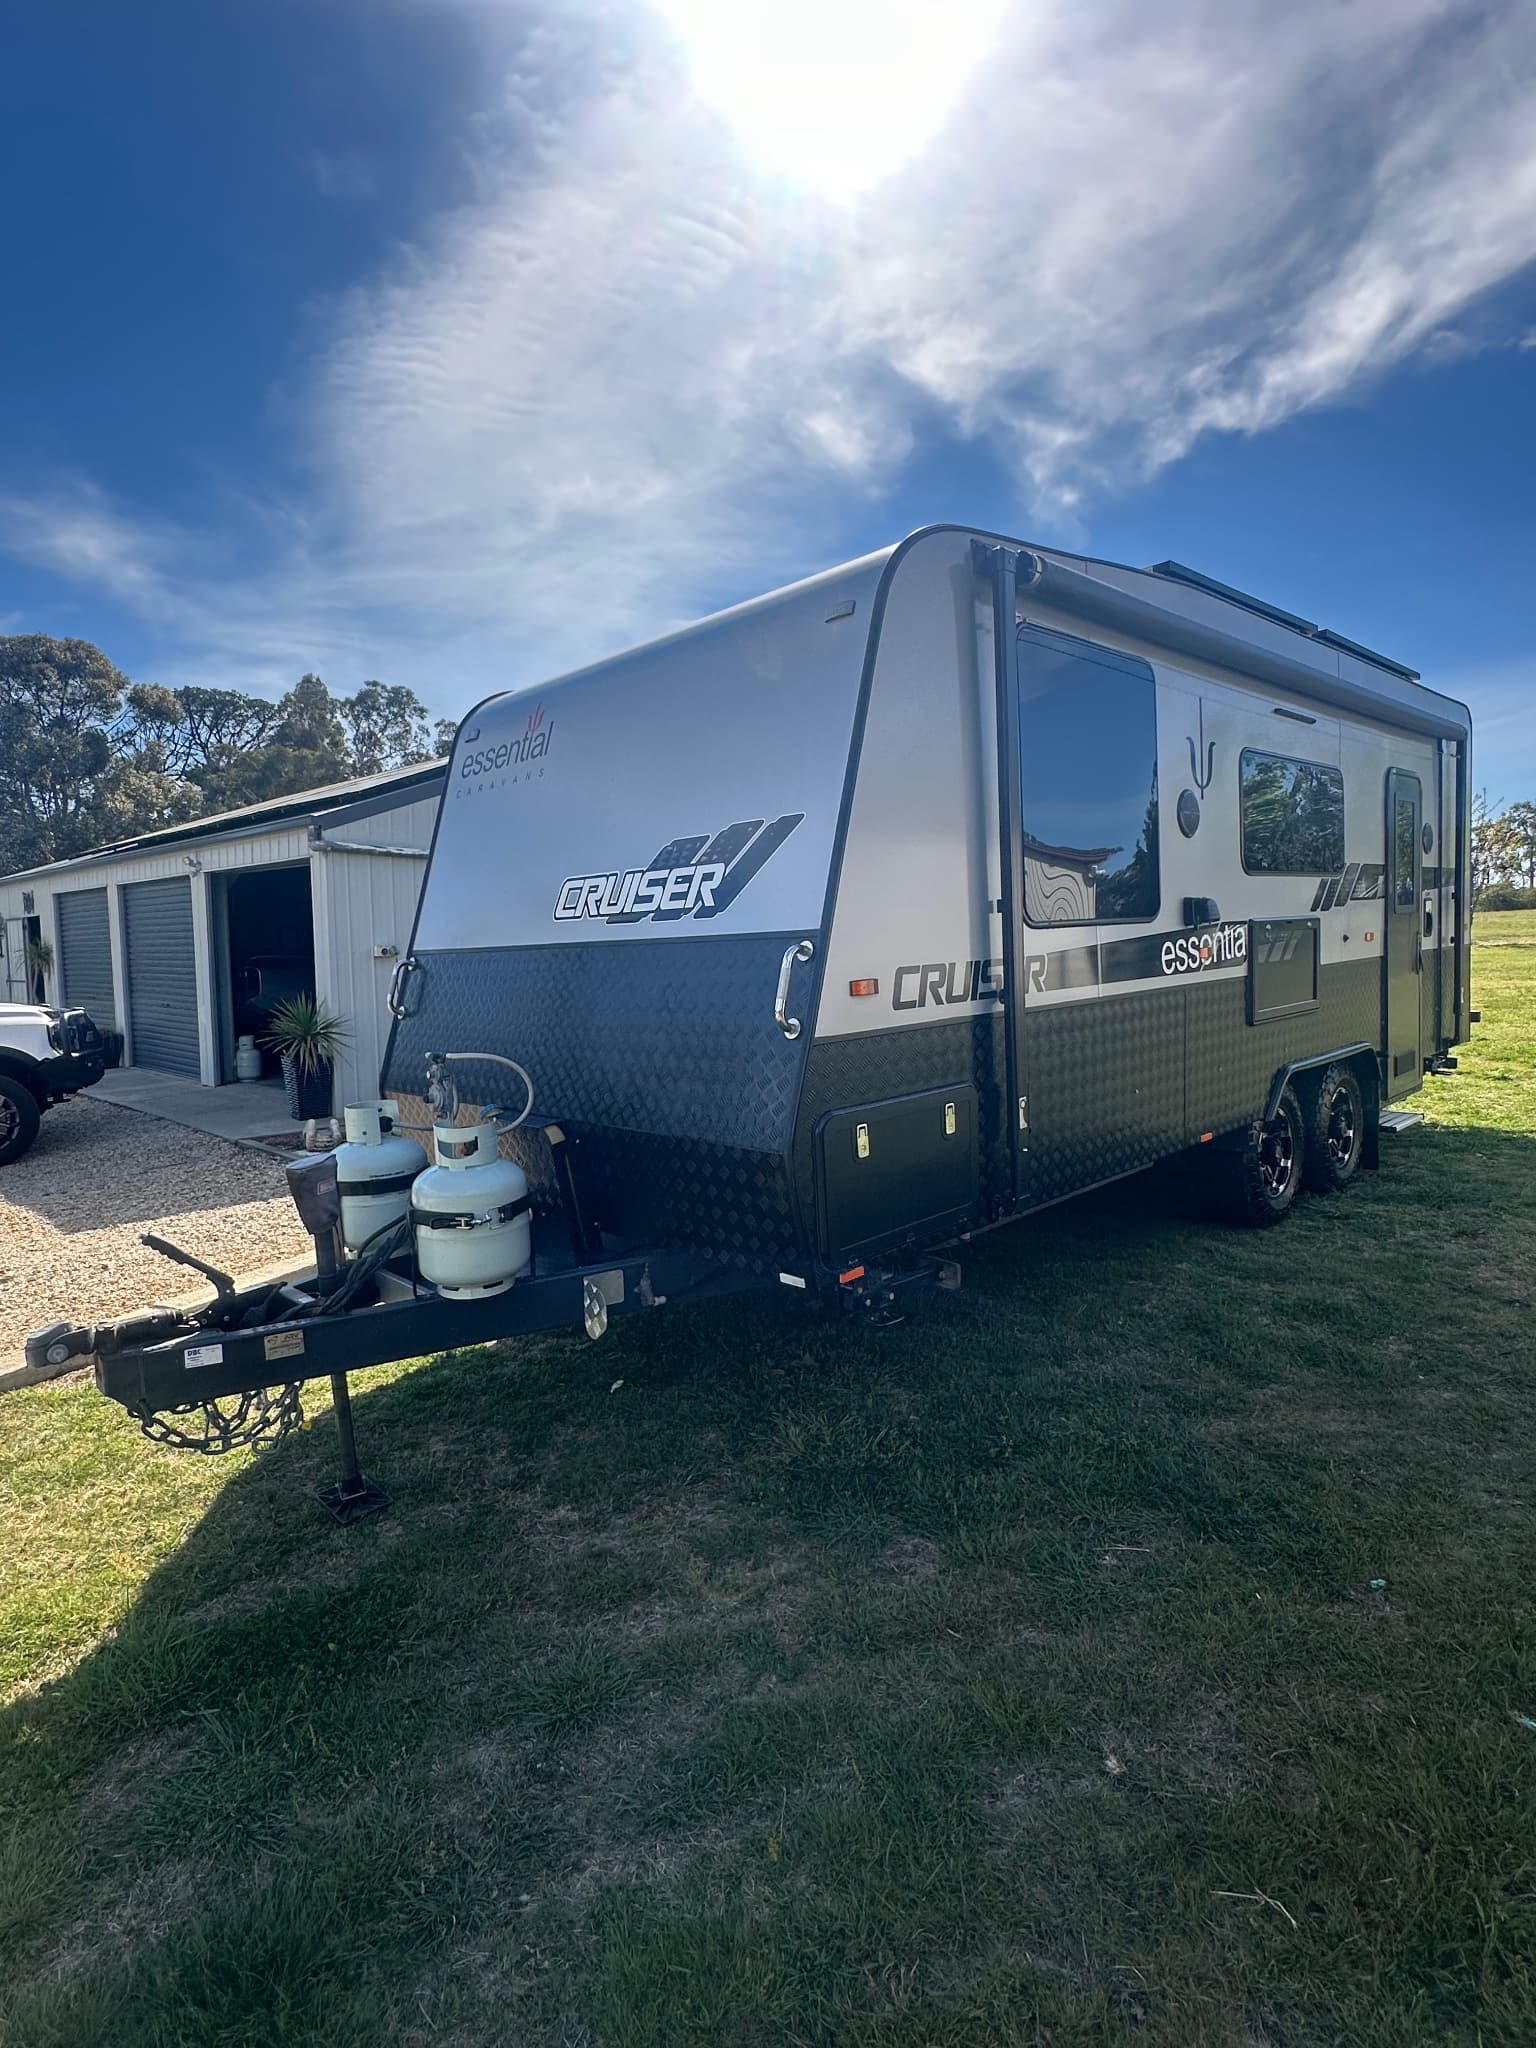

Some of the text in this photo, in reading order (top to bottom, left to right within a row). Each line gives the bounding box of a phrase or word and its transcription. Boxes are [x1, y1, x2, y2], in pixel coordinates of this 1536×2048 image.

[461, 720, 554, 779] essential
[456, 767, 545, 800] CARAVANS
[555, 863, 726, 919] CRUISER
[1161, 923, 1247, 975] essentia
[892, 953, 1046, 1011] CRUISR
